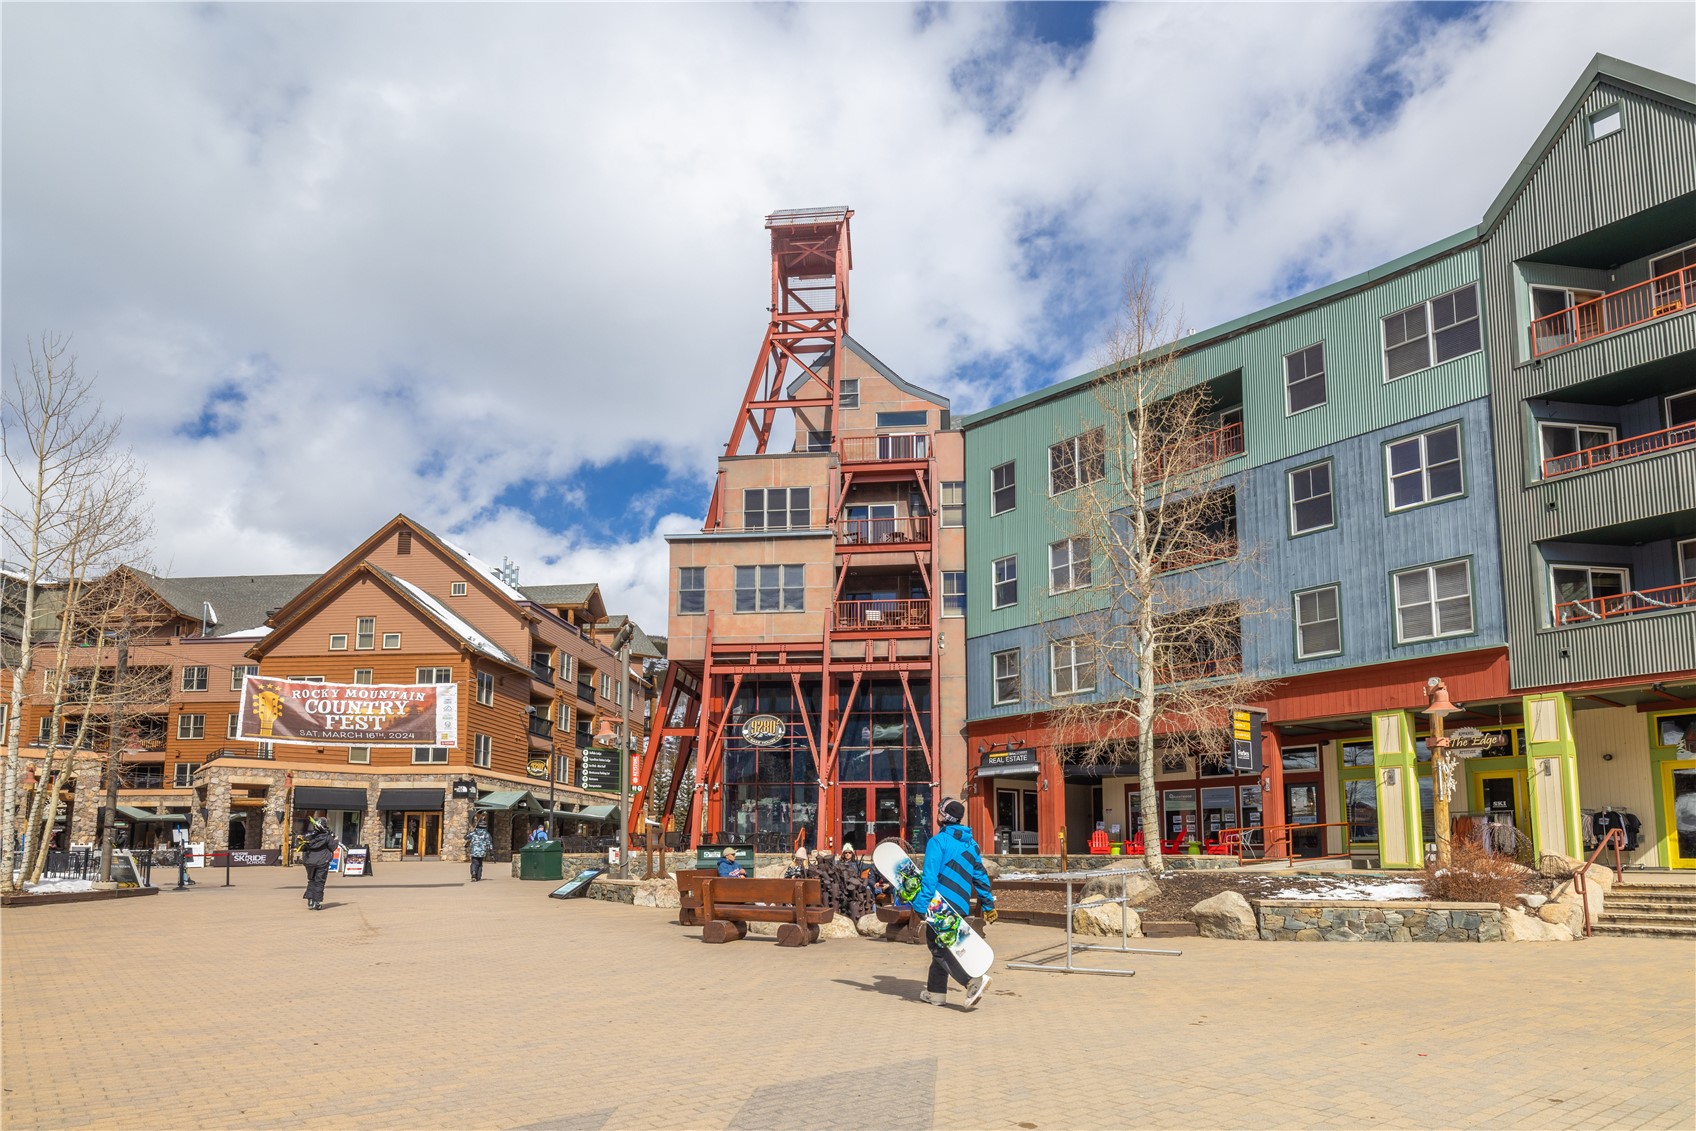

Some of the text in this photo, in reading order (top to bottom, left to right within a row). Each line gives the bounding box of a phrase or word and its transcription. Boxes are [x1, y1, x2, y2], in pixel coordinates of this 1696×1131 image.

[292, 688, 340, 699] ROCKY
[345, 688, 426, 702] MOUNTAIN
[304, 699, 410, 715] COUNTRY
[324, 714, 387, 730] FEST
[299, 729, 320, 737] SAT.
[322, 731, 363, 739] MARCH
[1450, 733, 1497, 750] The Edge
[1005, 754, 1028, 762] ESTATE
